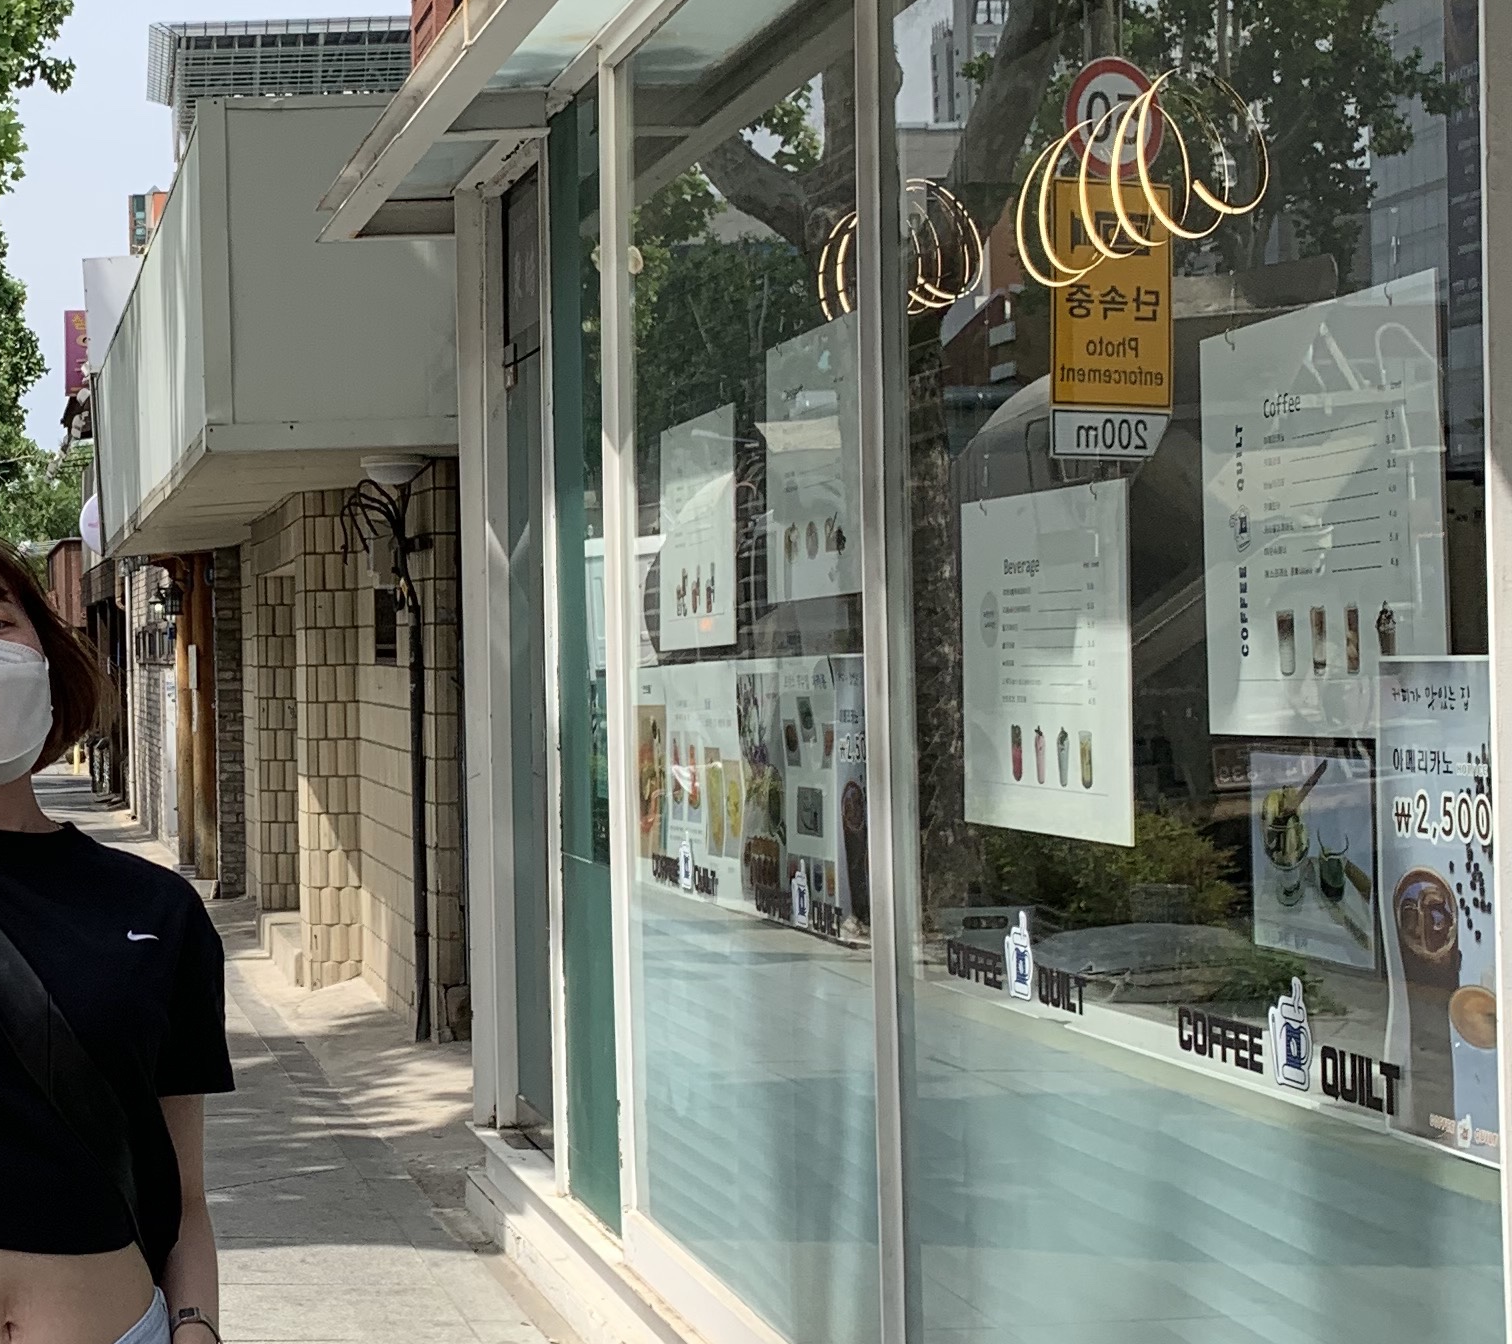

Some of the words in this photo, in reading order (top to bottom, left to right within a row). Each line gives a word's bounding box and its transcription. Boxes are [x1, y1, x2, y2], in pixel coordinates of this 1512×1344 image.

[1262, 392, 1302, 418] Coffee
[1003, 558, 1040, 577] Beverage
[1238, 566, 1250, 657] COFFEE
[1392, 747, 1454, 776] 아메리카노
[1393, 790, 1492, 844] ₩2,500
[947, 939, 1003, 991] COFFEE
[1037, 962, 1088, 1016] QUILT
[1177, 1006, 1264, 1075] COFFEE
[1320, 1045, 1401, 1116] QUILT
